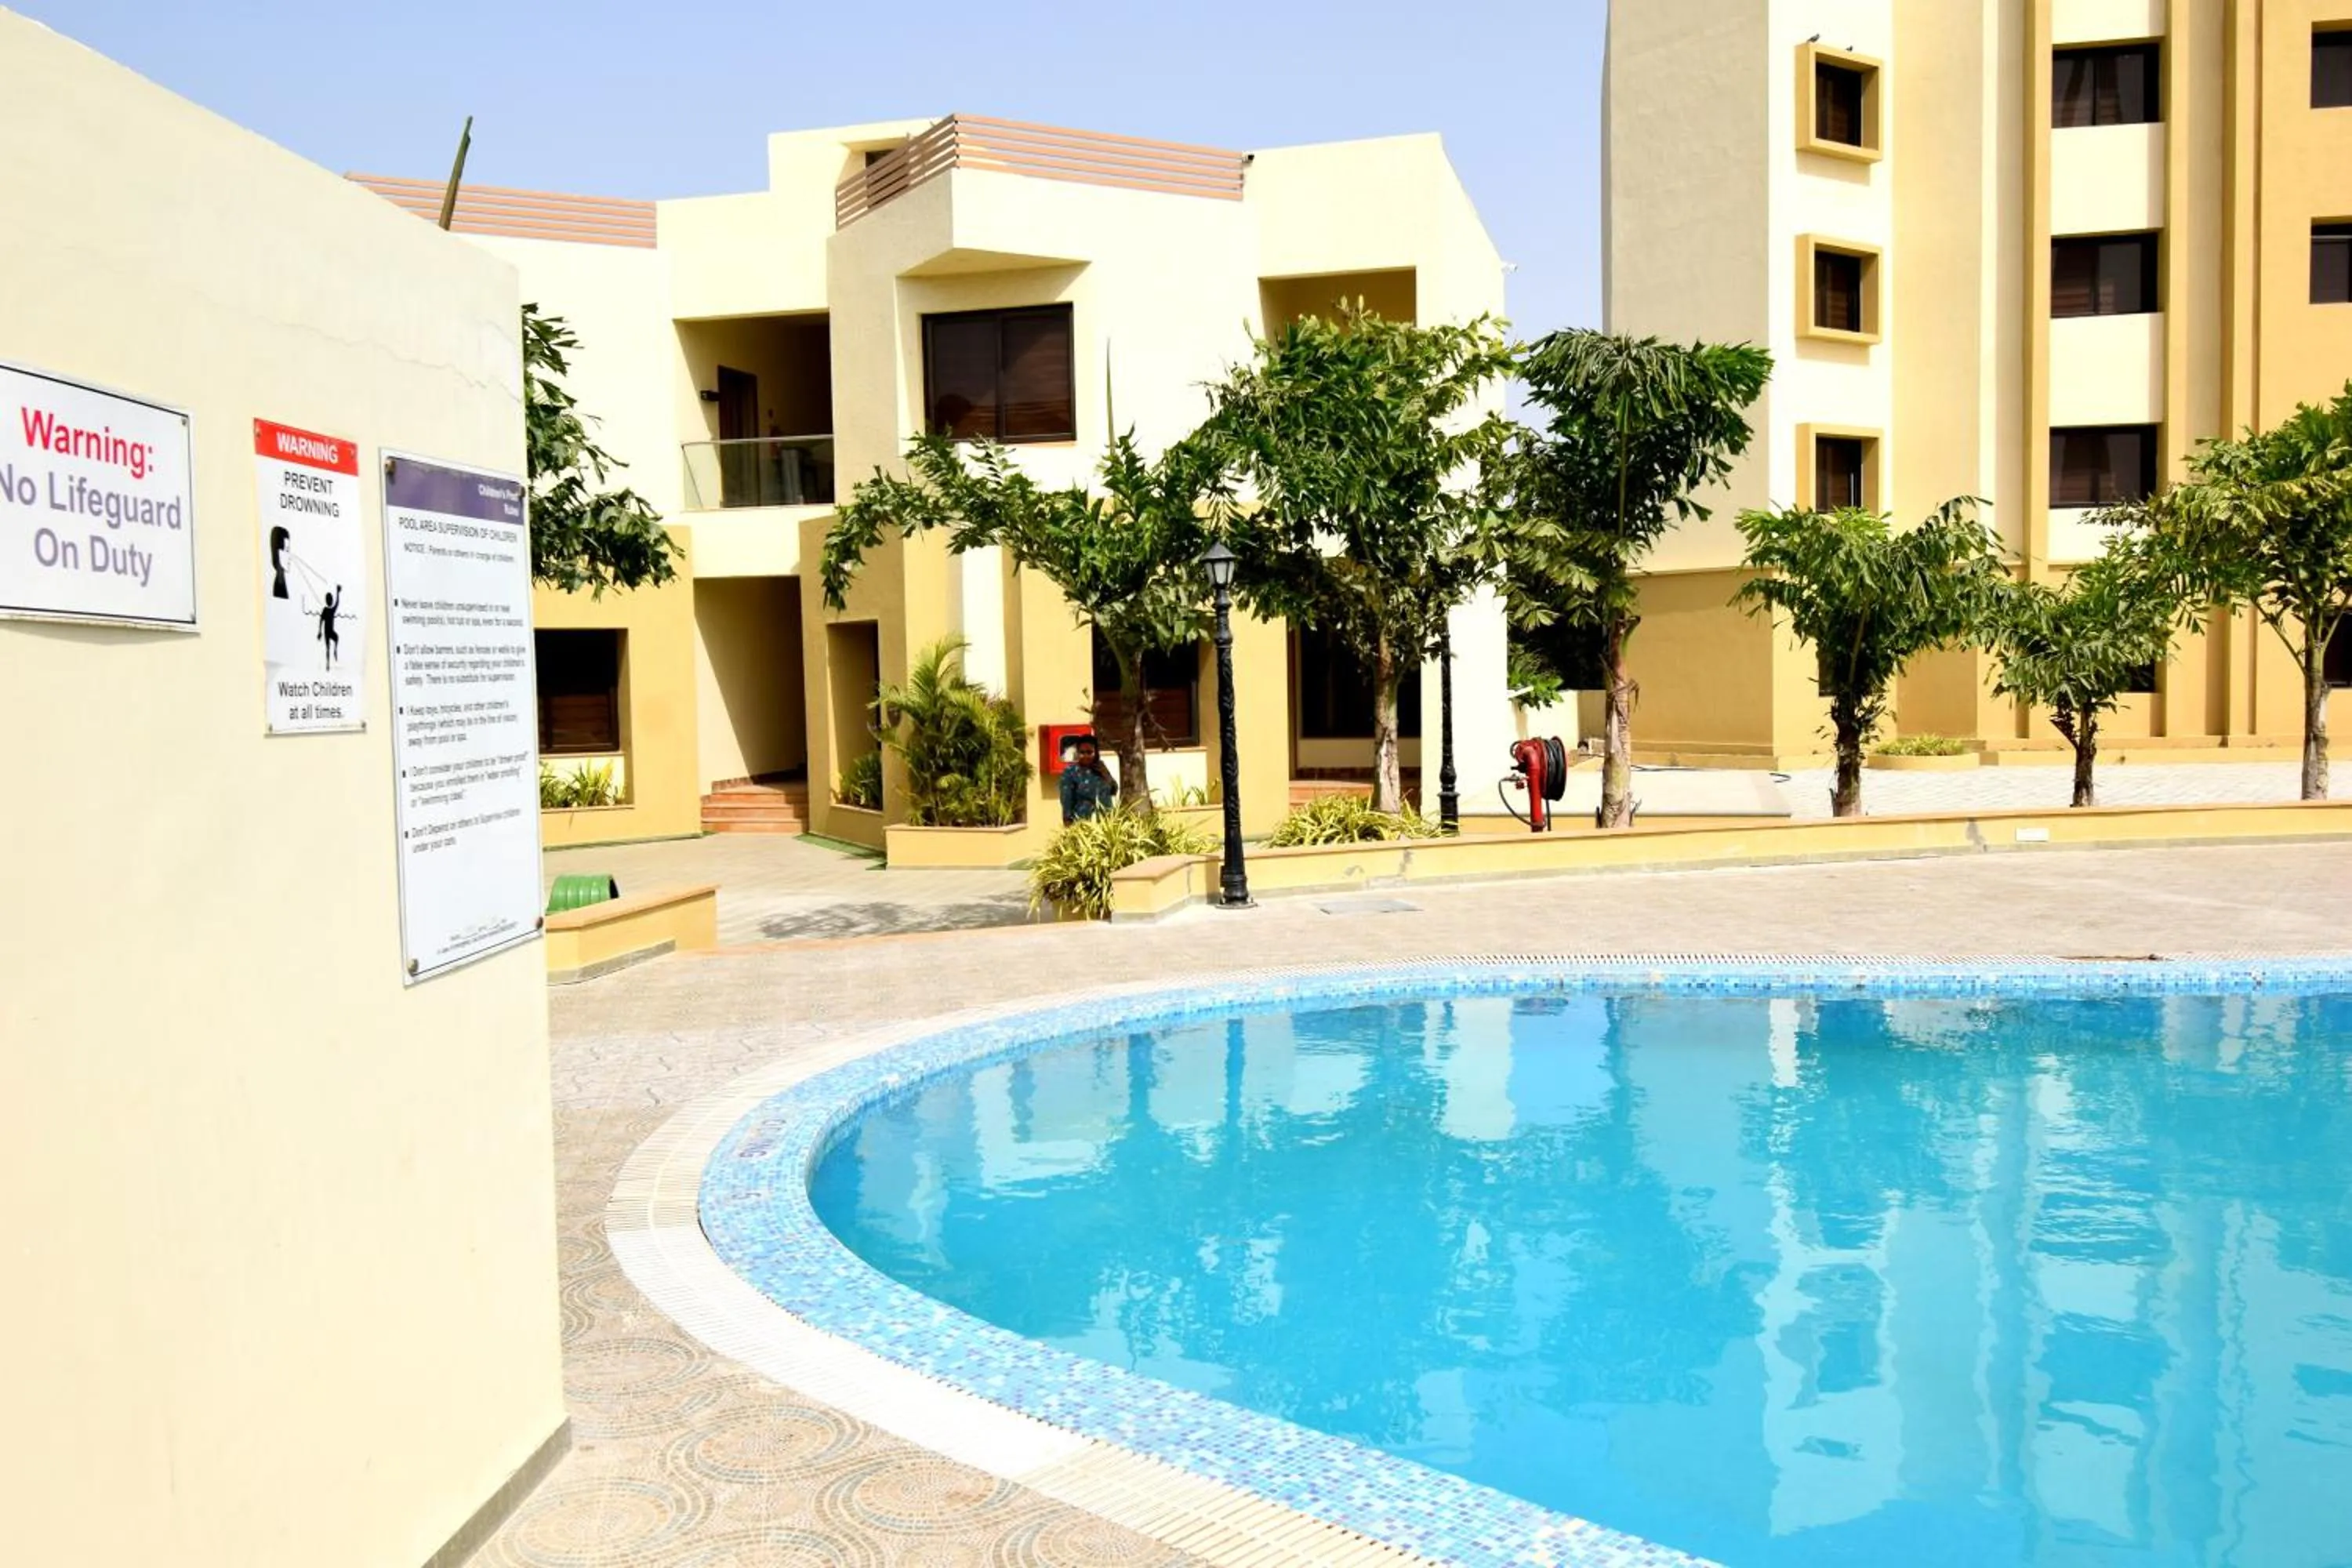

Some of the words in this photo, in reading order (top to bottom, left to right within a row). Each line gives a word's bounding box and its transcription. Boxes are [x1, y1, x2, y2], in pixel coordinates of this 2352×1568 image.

[21, 406, 154, 480] Warning:
[276, 432, 339, 464] WARNING
[284, 471, 333, 494] PREVENT
[49, 471, 182, 529] Lifeguard
[280, 493, 339, 517] DROWNING
[398, 517, 418, 530] POOL
[419, 521, 437, 532] AREA
[439, 522, 478, 537] SUPERVISION
[480, 528, 488, 539] OF
[34, 528, 78, 569] On
[89, 535, 152, 587] Duty
[278, 682, 309, 696] Watch
[313, 681, 352, 696] Children
[289, 706, 299, 719] at
[301, 705, 312, 719] all
